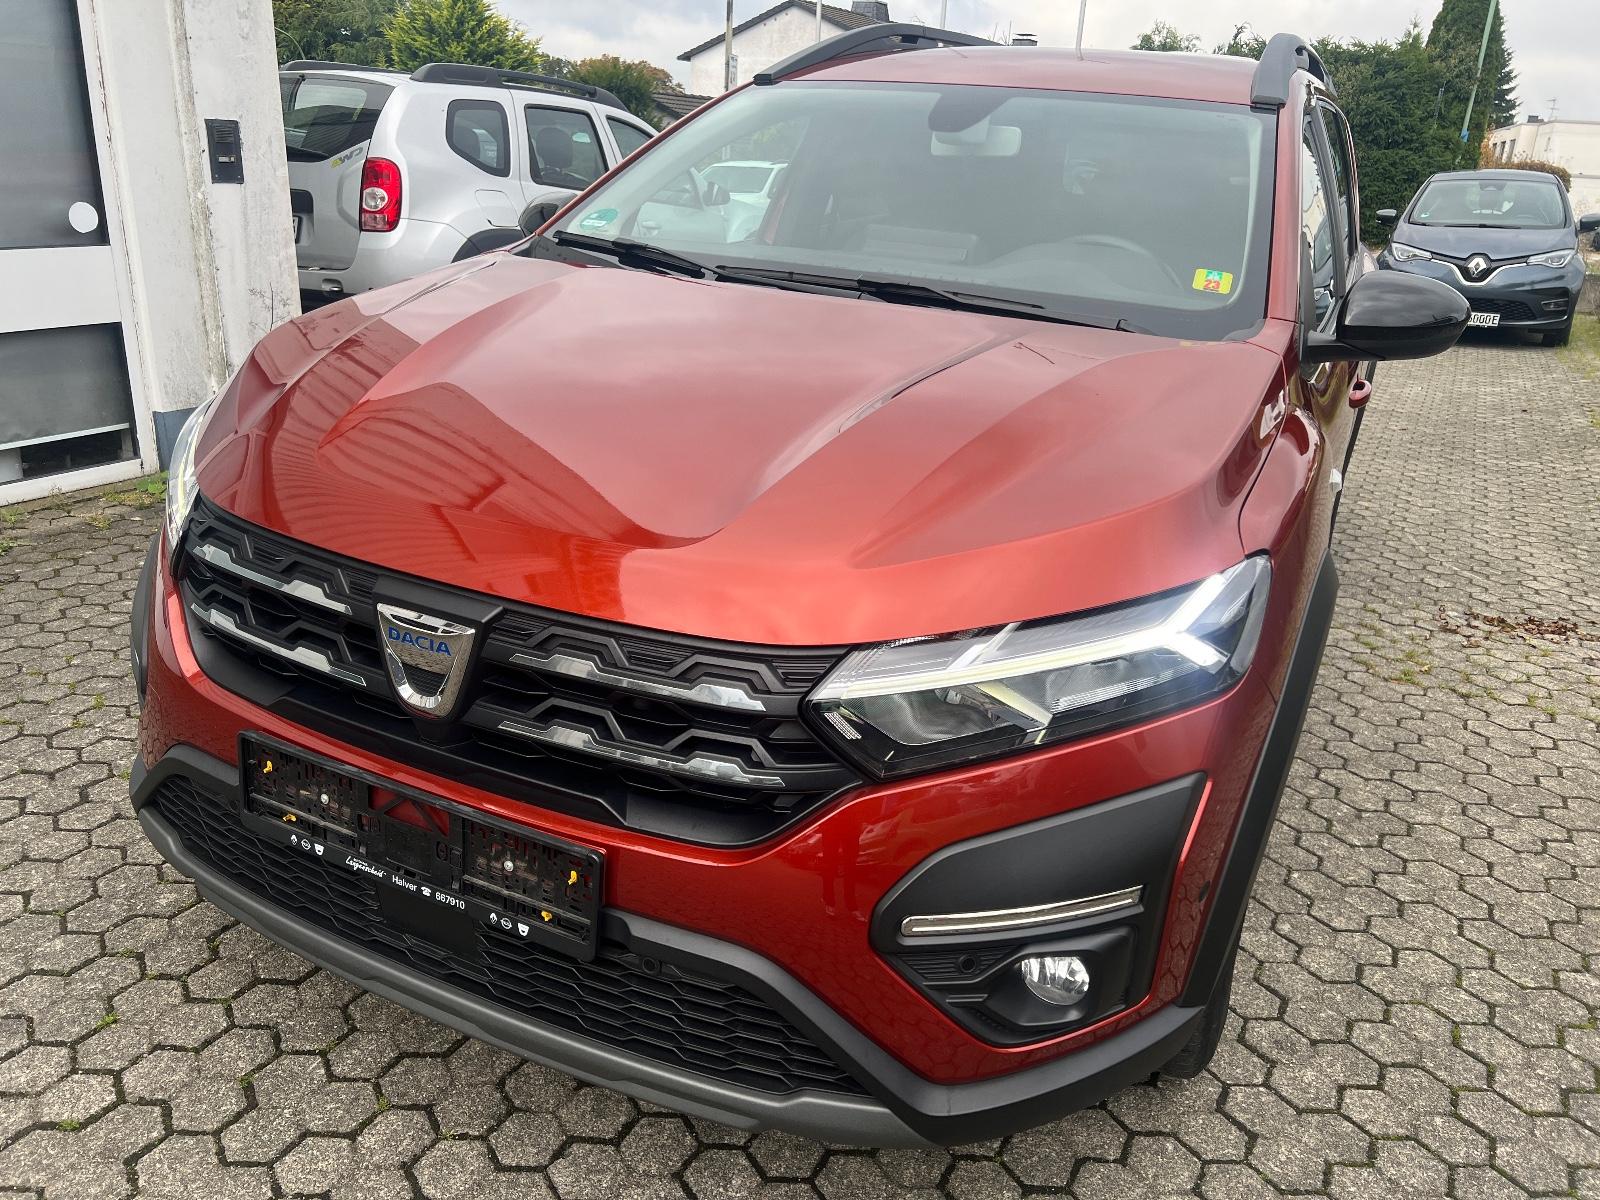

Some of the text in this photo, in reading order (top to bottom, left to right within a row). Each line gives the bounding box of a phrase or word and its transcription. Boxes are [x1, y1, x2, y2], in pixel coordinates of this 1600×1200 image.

[1204, 279, 1221, 290] 23
[388, 626, 452, 657] DACIA
[392, 874, 418, 892] Halver
[435, 891, 465, 910] 667910
